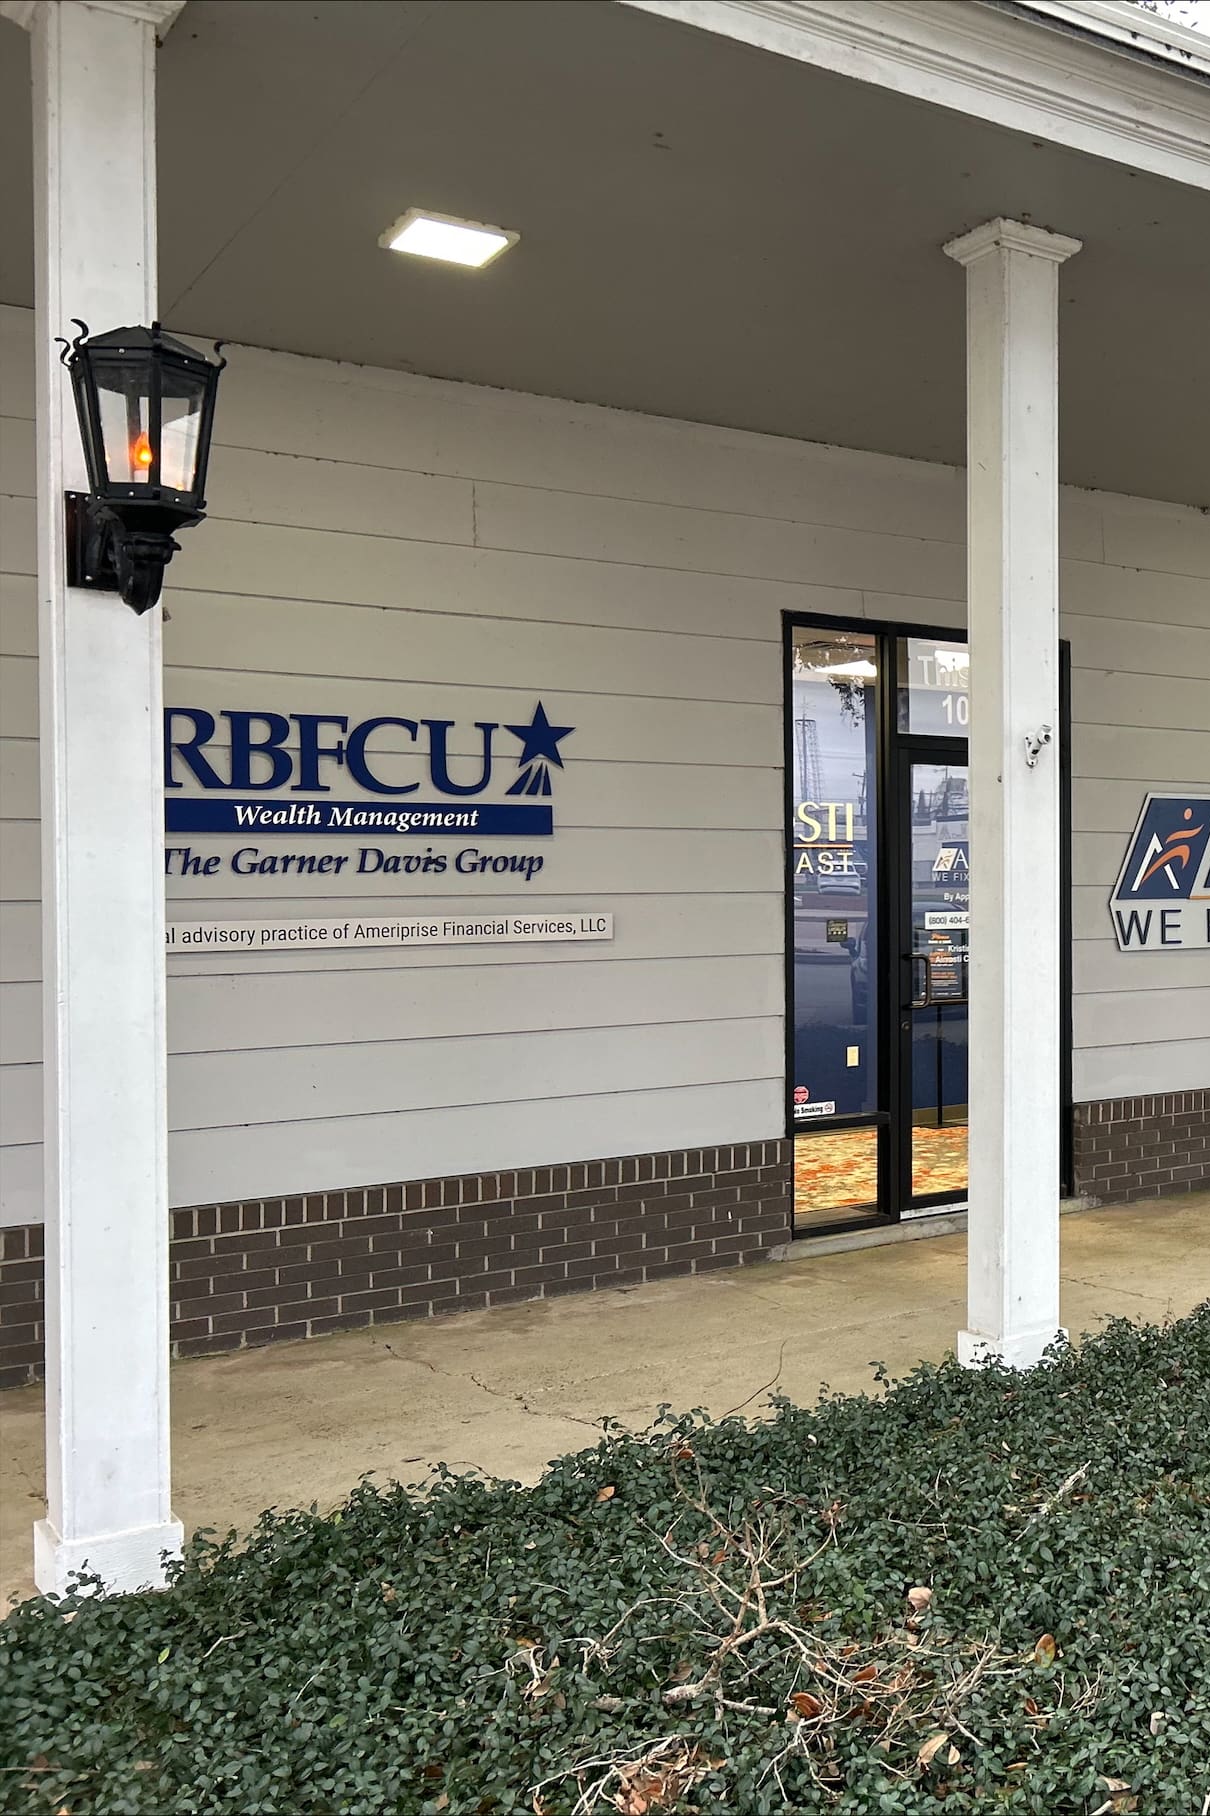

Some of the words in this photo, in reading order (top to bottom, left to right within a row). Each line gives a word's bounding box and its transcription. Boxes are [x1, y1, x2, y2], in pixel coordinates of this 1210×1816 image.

[164, 707, 499, 796] RBFCU
[233, 804, 321, 826] Wealth
[327, 806, 479, 832] Management
[794, 801, 853, 842] STI
[164, 847, 220, 875] The
[231, 847, 348, 875] Garner
[356, 847, 447, 874] Davis
[455, 848, 544, 881] Group
[932, 872, 949, 882] WE
[182, 926, 255, 945] advisory
[261, 925, 327, 944] practice
[333, 923, 350, 939] of
[354, 922, 438, 941] Ameriprise
[443, 920, 509, 938] Financial
[513, 919, 576, 936] Services,
[580, 917, 607, 933] LLC
[1116, 908, 1182, 946] WE
